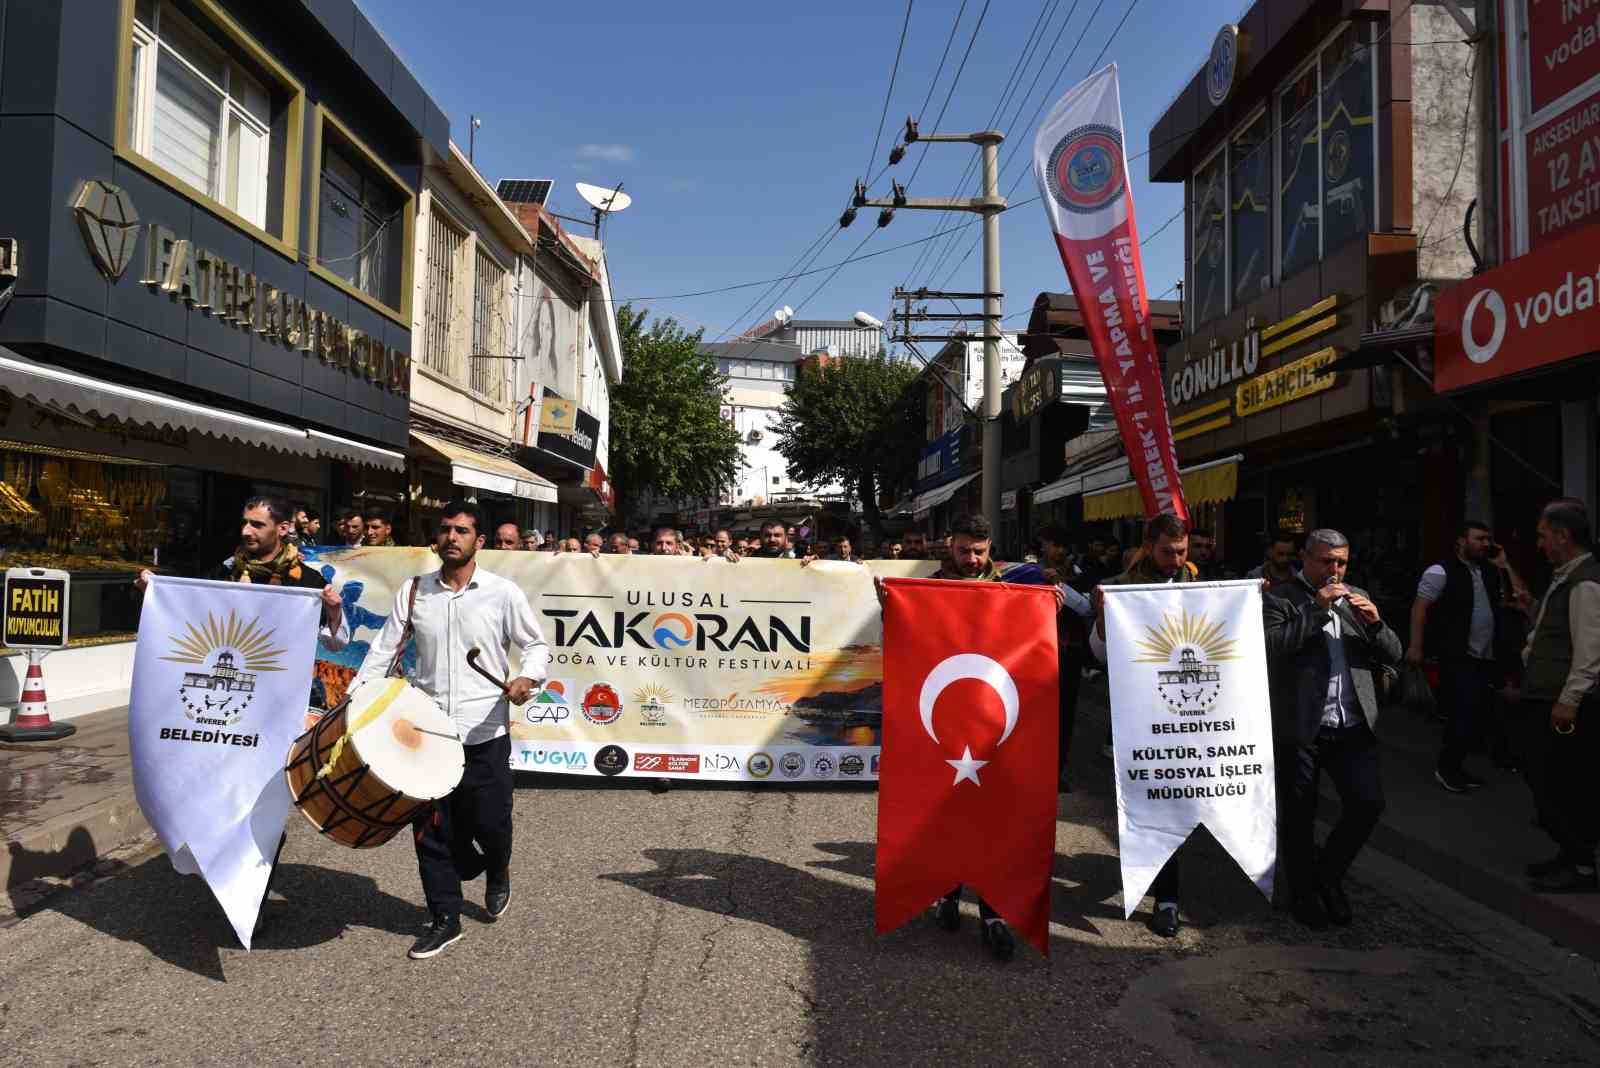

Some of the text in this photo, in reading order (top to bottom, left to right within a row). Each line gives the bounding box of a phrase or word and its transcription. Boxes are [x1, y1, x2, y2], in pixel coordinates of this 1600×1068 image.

[1547, 152, 1570, 191] 12
[1085, 249, 1109, 284] VE
[1099, 286, 1136, 377] YAPMA
[1171, 317, 1259, 406] GÖNÜLLÜ
[12, 584, 59, 613] FATİH
[627, 590, 729, 608] ULUSAL
[8, 616, 61, 637] KUYUMCULUK
[542, 609, 811, 653] TAKORAN
[607, 656, 627, 666] VE
[638, 655, 707, 669] KÜLTÜR
[196, 716, 228, 727] SİVEREK
[527, 705, 569, 723] GAP
[1151, 718, 1235, 735] BELEDİYESİ
[160, 728, 259, 747] BELEDİYESİ
[1132, 744, 1256, 761] KÜLTÜR, SANAT
[1127, 763, 1263, 781] VE SOSYAL İŞLER
[1147, 782, 1247, 800] MÜDÜRLÜĞÜ
